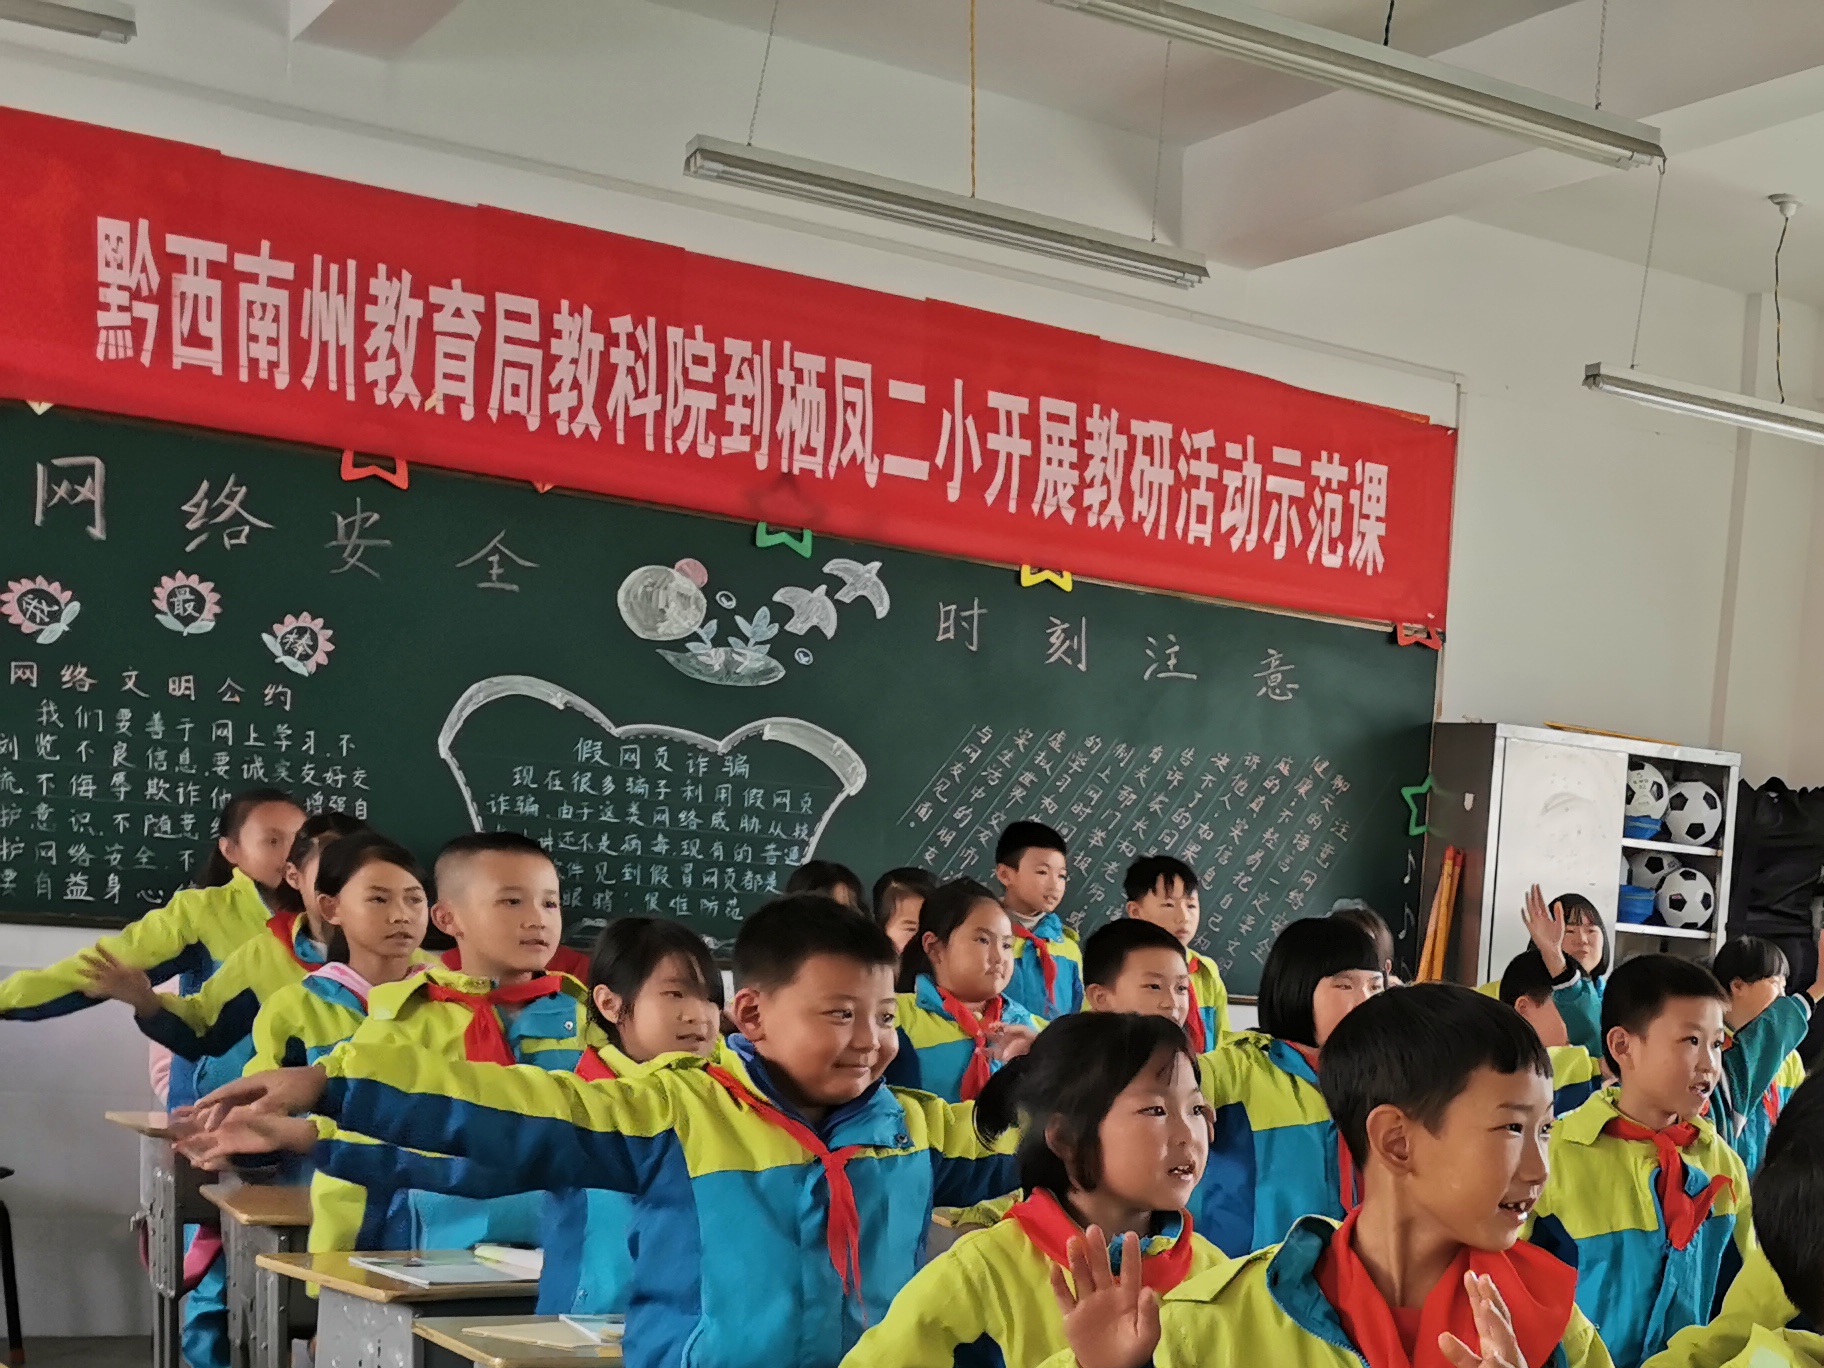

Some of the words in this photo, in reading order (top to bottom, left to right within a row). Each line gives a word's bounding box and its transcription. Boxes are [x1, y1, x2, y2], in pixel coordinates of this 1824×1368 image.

[96, 216, 1389, 576] 黔西南州教育局教科院到栖凤二小开展教研活动示范课
[34, 455, 540, 593] 网络安全
[170, 586, 200, 617] 最
[935, 596, 1300, 702] 时刻注意
[10, 661, 293, 712] 网络文明公约
[573, 737, 750, 779] 假网页诈骗
[512, 764, 813, 815] 现在很多骗子利用假网页
